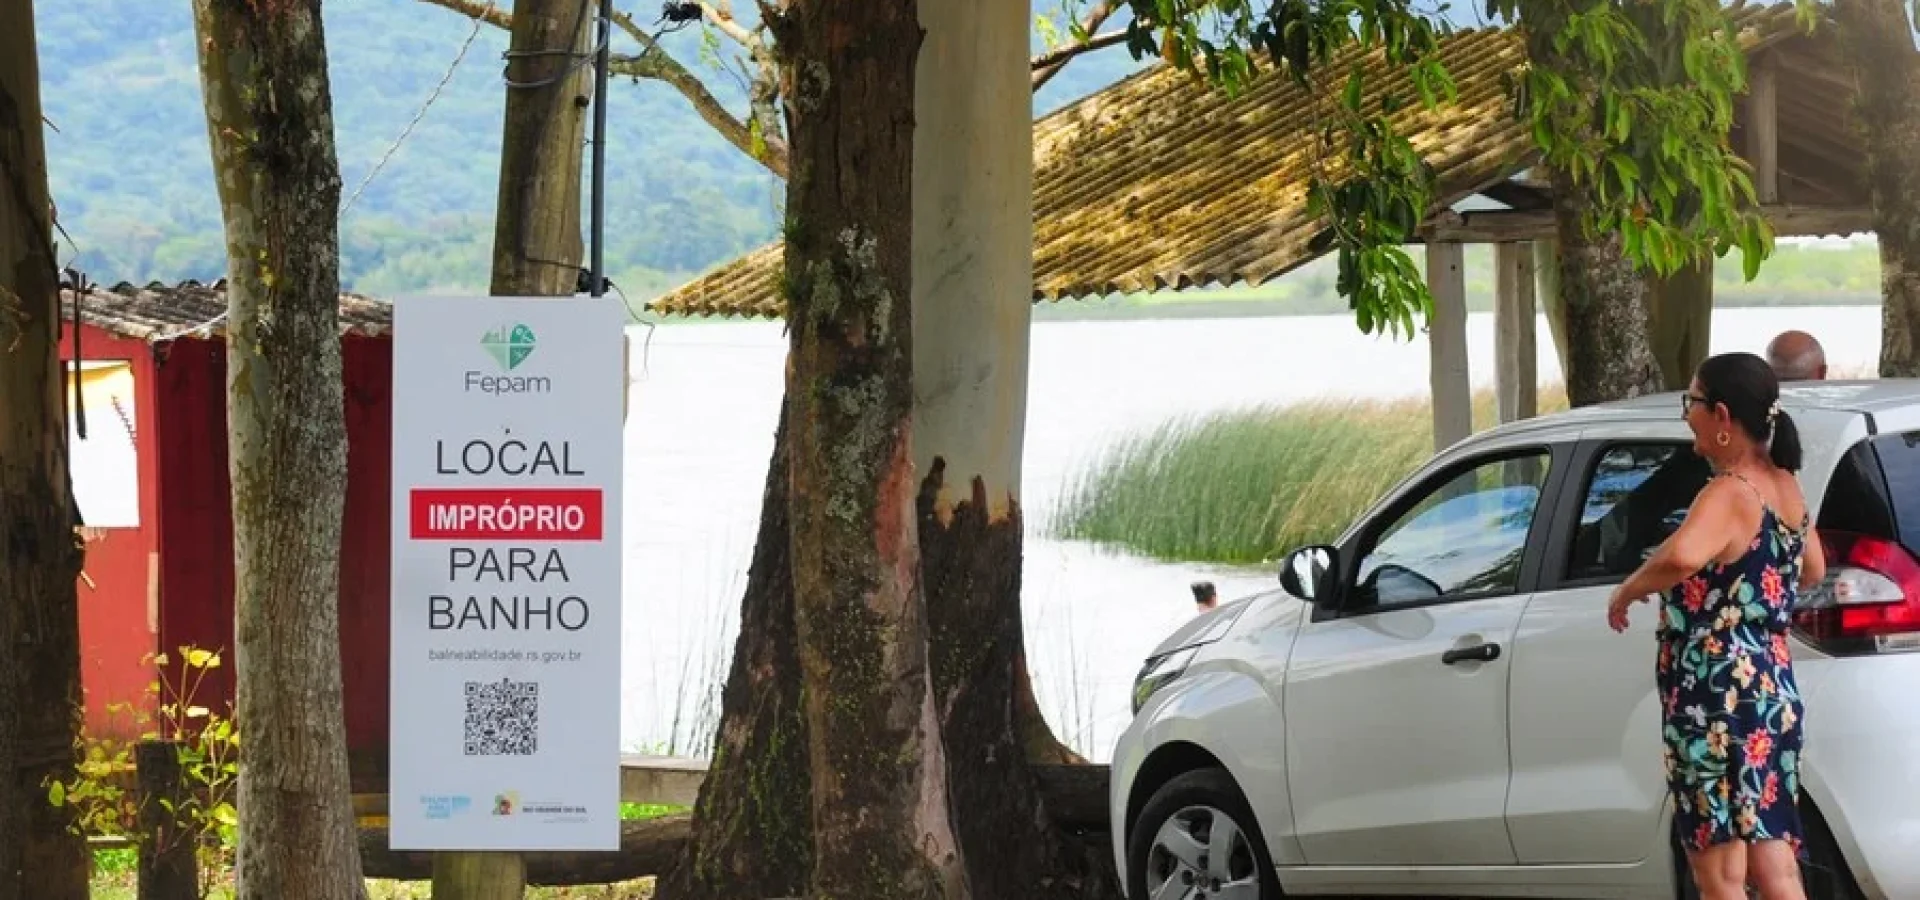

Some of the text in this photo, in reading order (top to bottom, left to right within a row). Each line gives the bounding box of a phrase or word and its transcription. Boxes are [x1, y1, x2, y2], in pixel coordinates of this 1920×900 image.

[464, 370, 551, 396] Fepam
[436, 439, 585, 477] LOCAL
[428, 498, 585, 532] IMPRÓPRIO
[449, 547, 570, 583] PARA
[428, 595, 590, 632] BANHO
